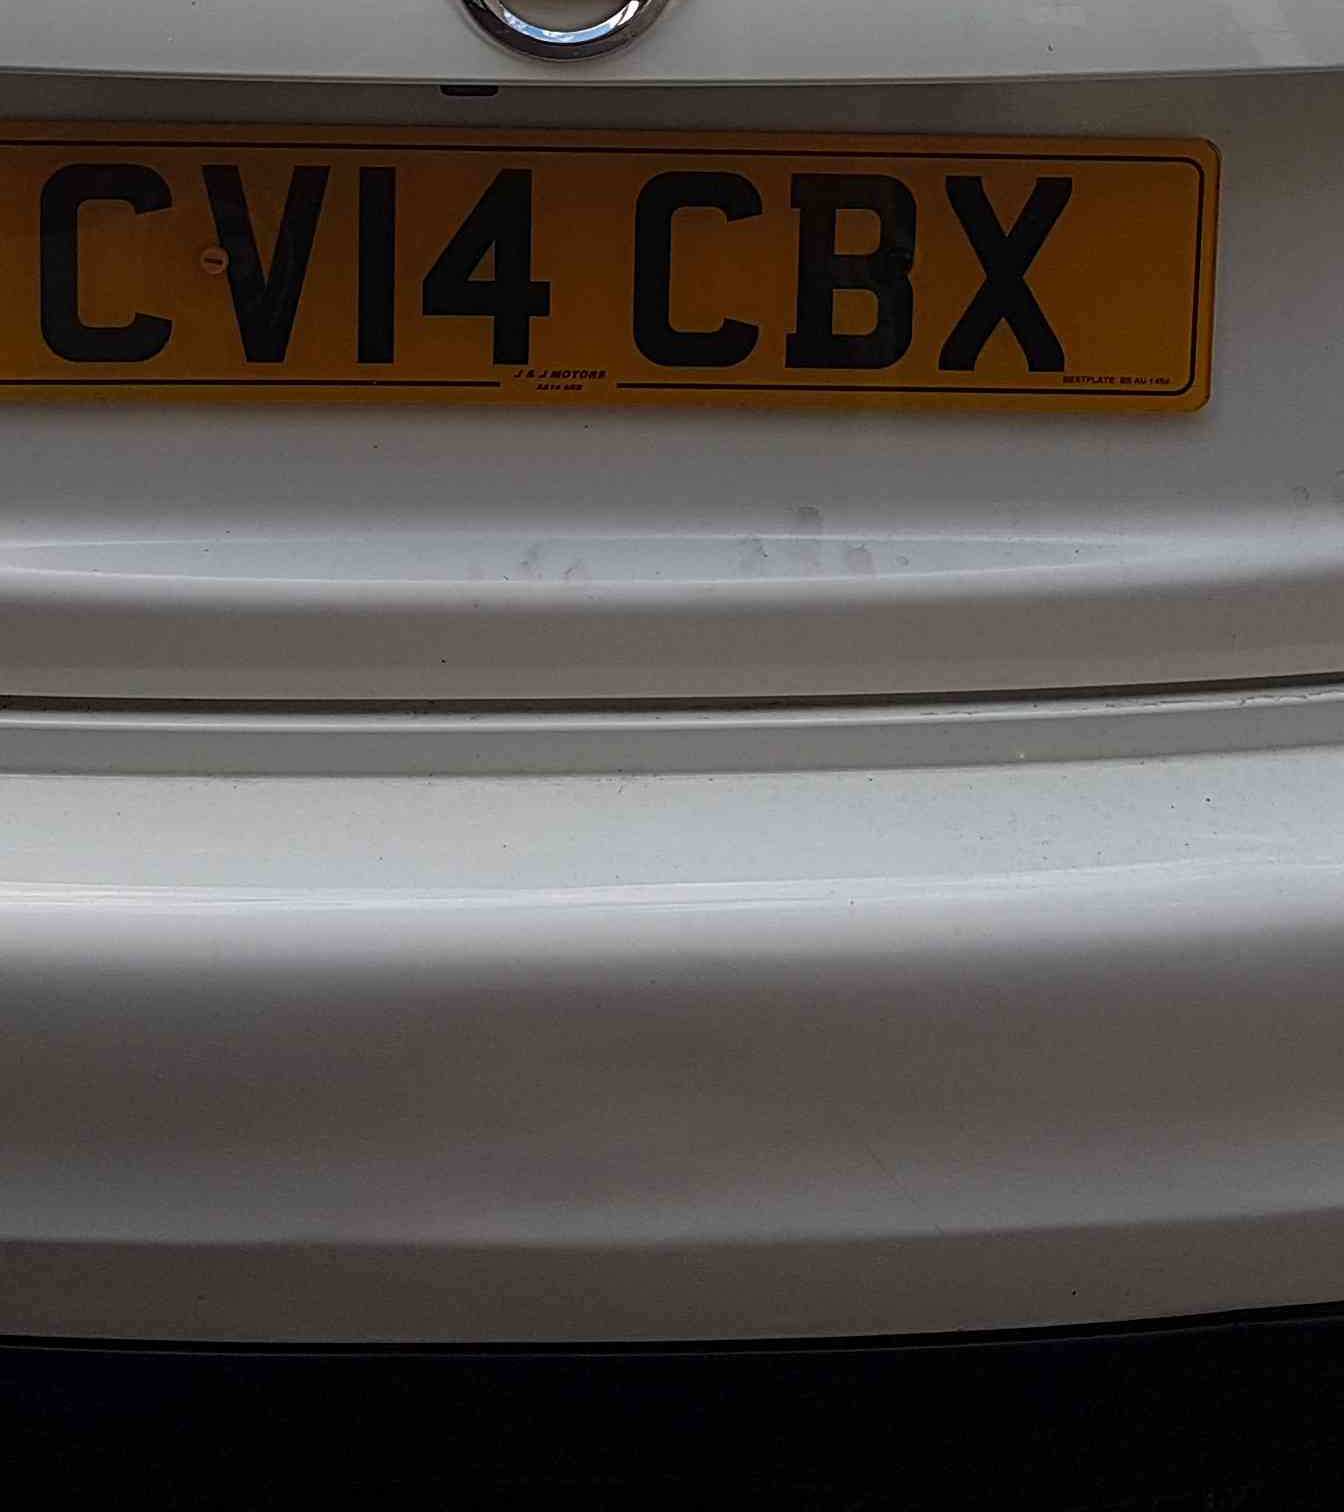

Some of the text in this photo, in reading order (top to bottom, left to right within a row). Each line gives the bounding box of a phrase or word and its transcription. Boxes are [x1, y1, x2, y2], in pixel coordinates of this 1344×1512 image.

[38, 161, 1074, 375] CV14 CBX
[550, 369, 607, 379] MOTORS
